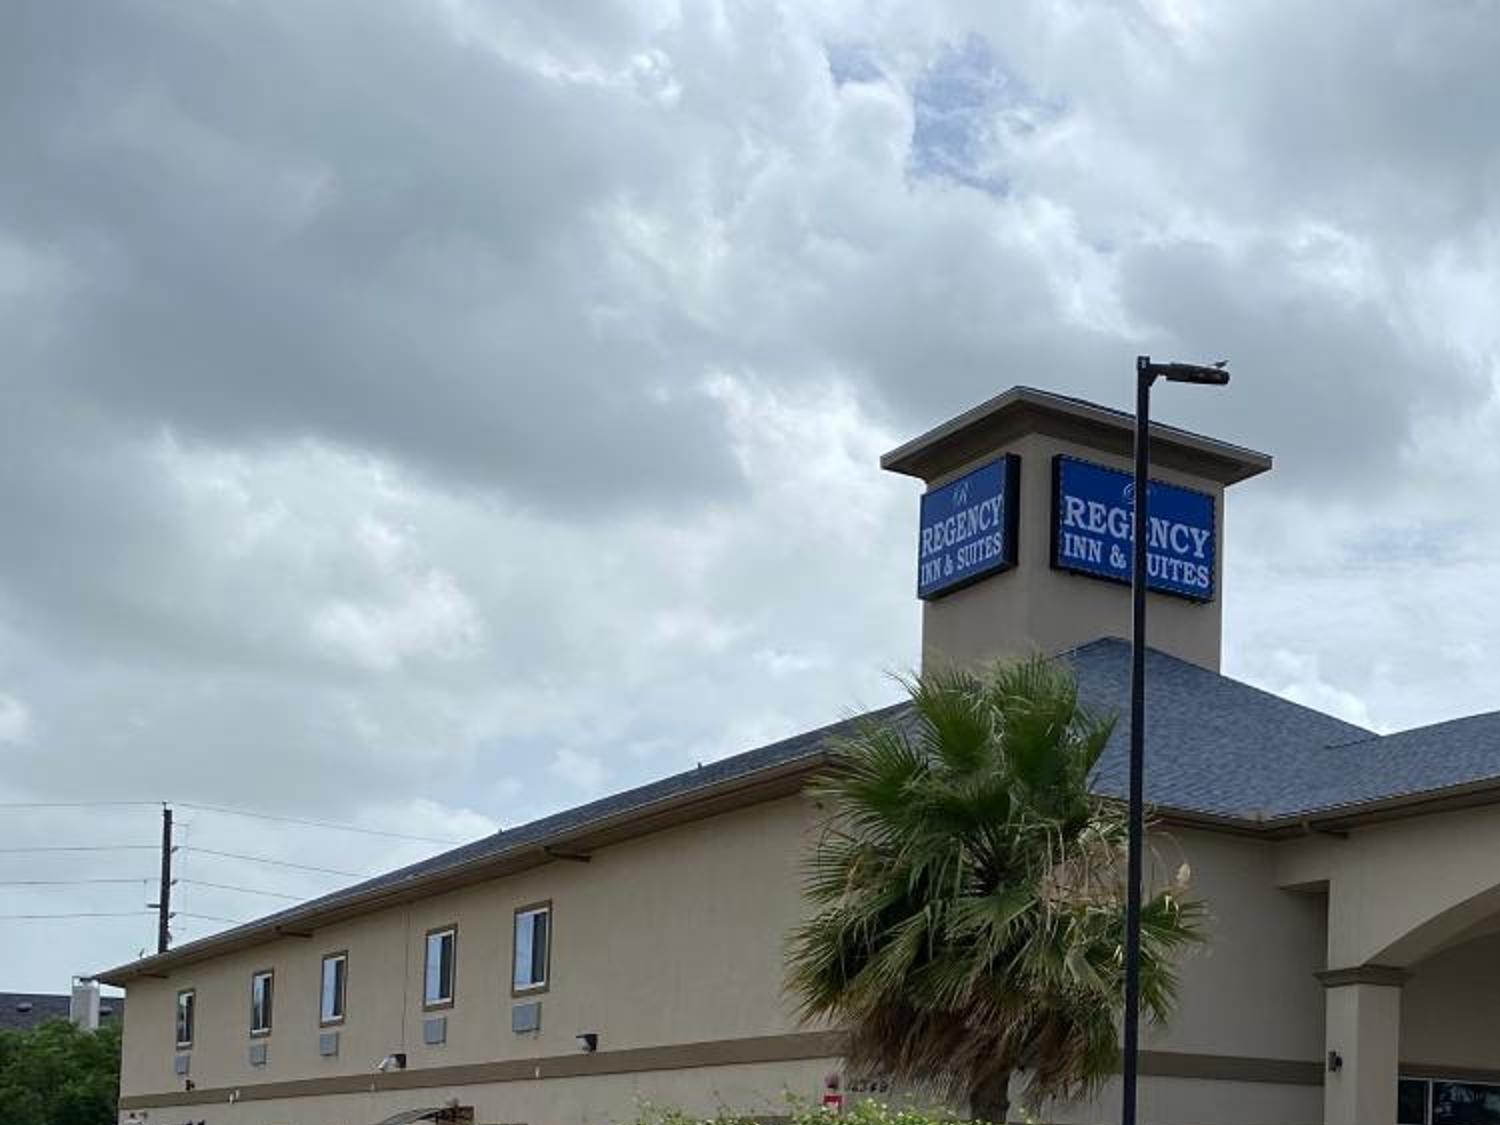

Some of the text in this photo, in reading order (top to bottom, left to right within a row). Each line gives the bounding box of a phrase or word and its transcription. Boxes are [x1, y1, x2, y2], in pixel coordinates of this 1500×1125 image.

[921, 494, 1003, 558] REGENCY
[920, 532, 1003, 586] INN & SUITES
[1063, 532, 1210, 588] INN & UITES
